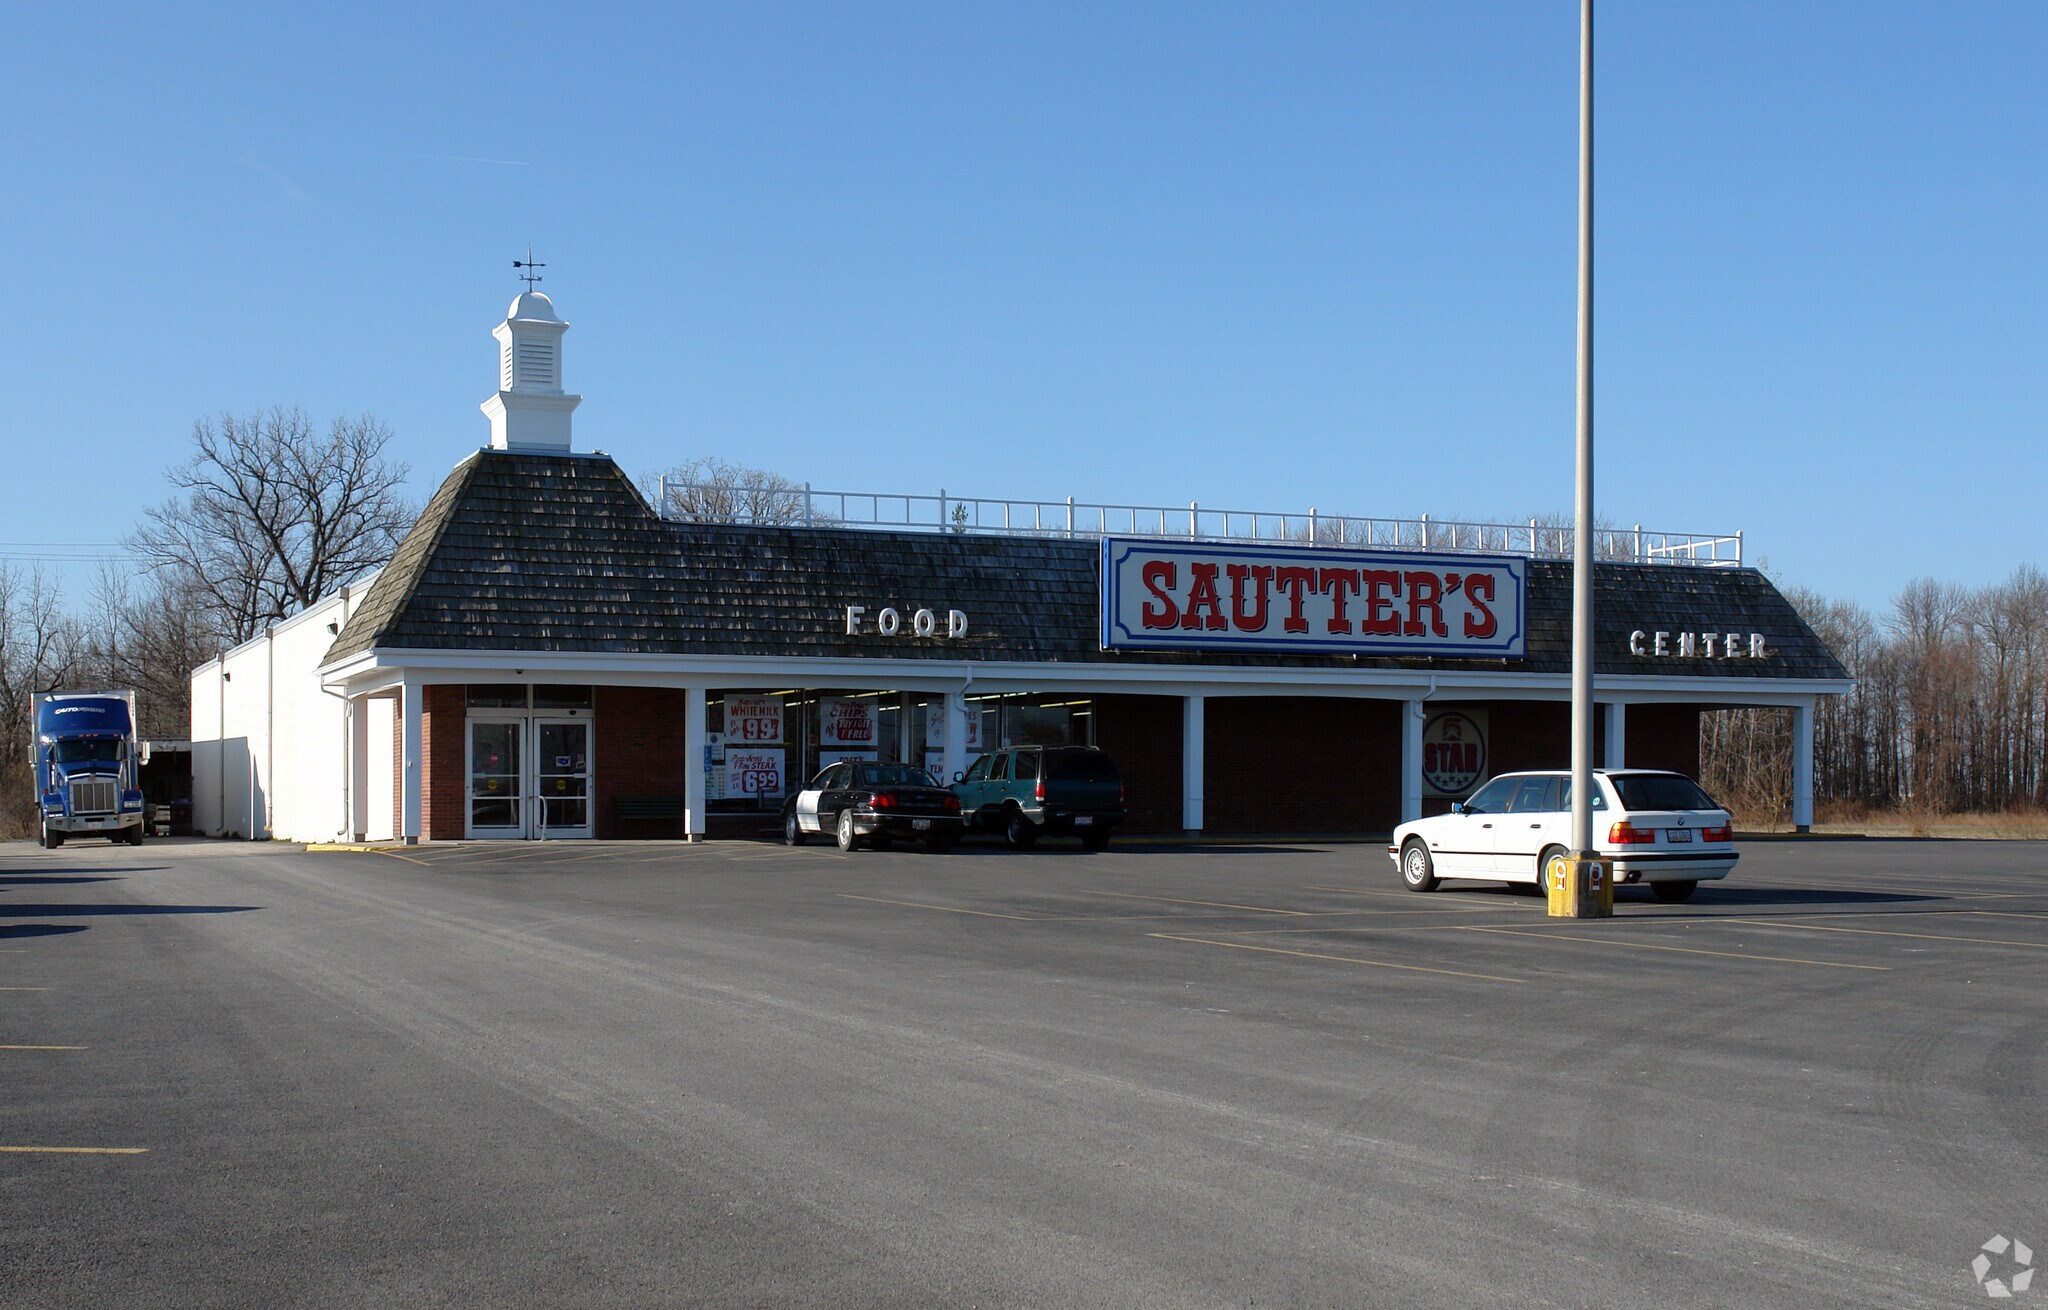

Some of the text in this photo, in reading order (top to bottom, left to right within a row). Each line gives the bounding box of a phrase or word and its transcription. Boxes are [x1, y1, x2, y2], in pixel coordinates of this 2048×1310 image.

[1141, 560, 1498, 638] SAUTTER'S
[846, 606, 968, 638] FOOD
[1630, 630, 1766, 658] CENTER
[731, 705, 779, 717] WHITE MILK
[830, 708, 868, 718] CHIPS
[848, 729, 868, 739] FREE
[1442, 717, 1462, 741] 5
[1425, 742, 1478, 773] STAR
